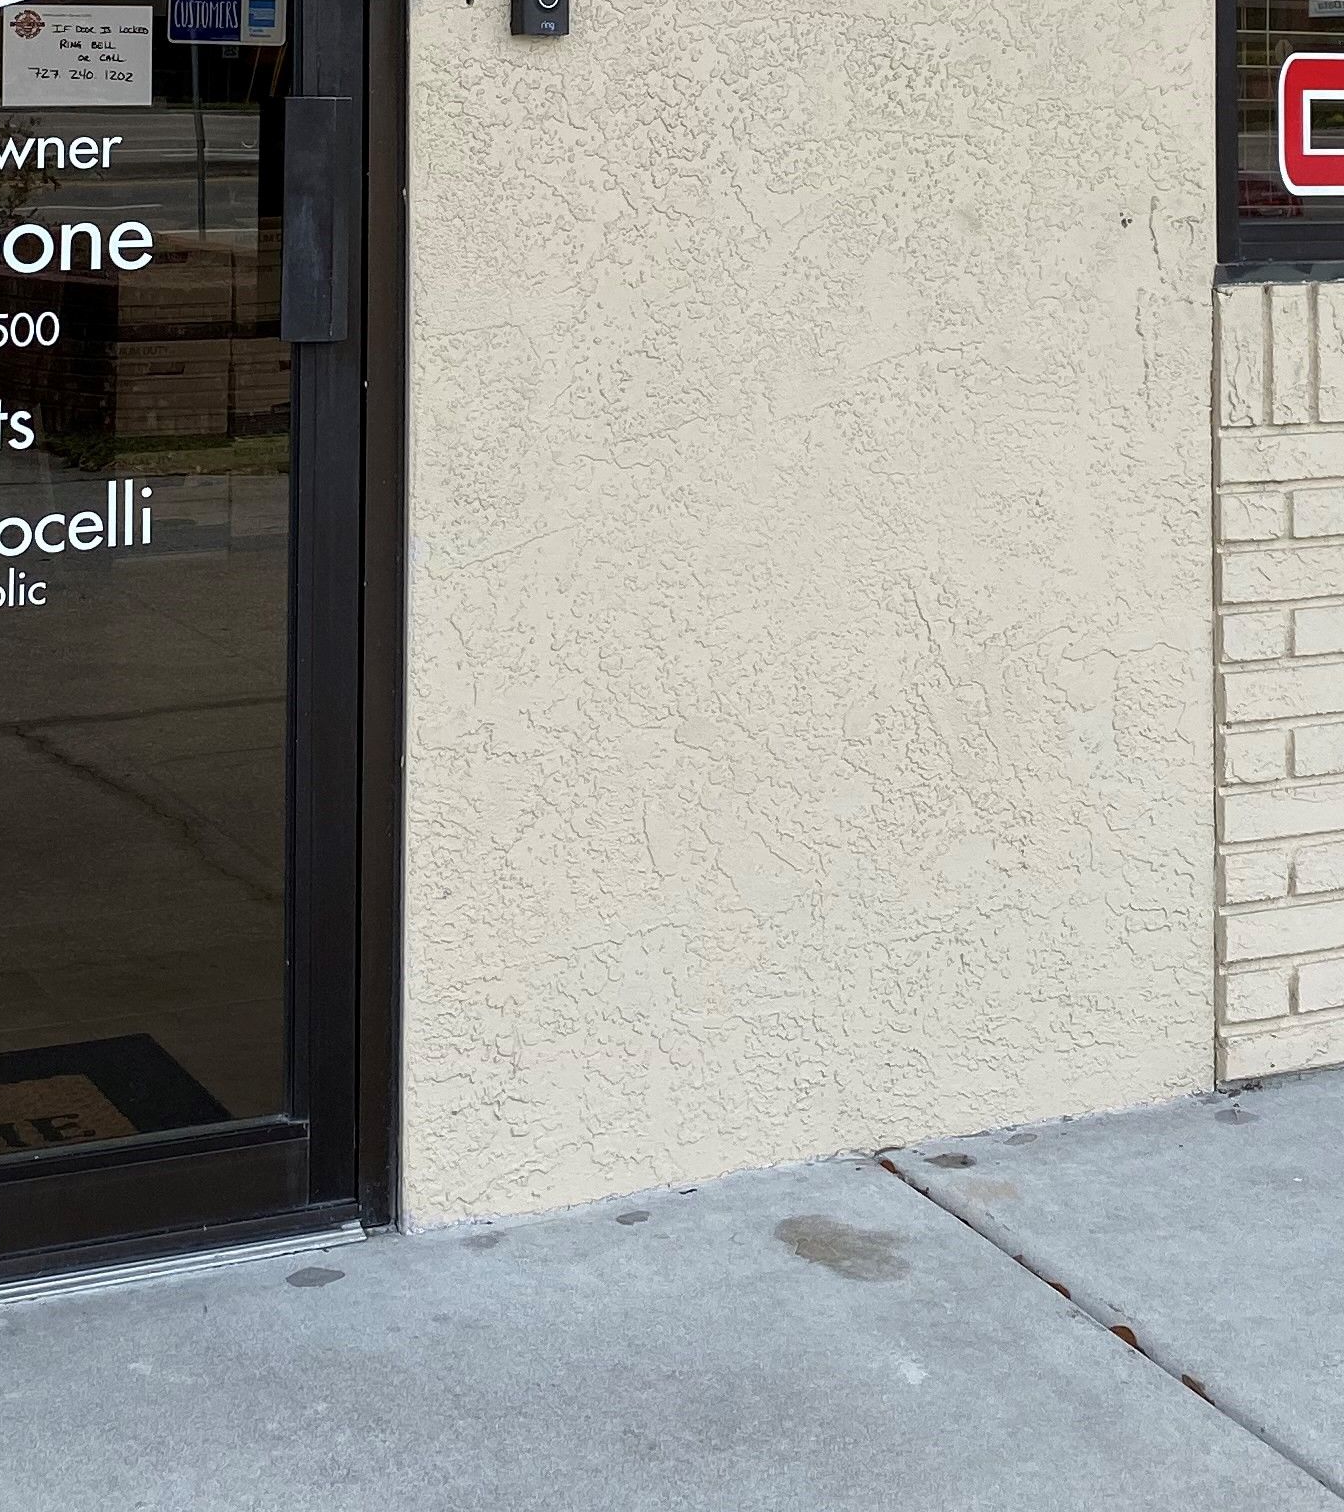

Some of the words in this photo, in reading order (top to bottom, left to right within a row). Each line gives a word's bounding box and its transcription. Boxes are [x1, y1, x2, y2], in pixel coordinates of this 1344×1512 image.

[174, 0, 239, 29] CUSTOMERS
[52, 24, 72, 34] IF
[540, 20, 555, 30] ring
[59, 38, 82, 50] RING
[91, 40, 116, 50] BELL
[99, 53, 127, 63] CALL
[104, 70, 134, 82] 1202
